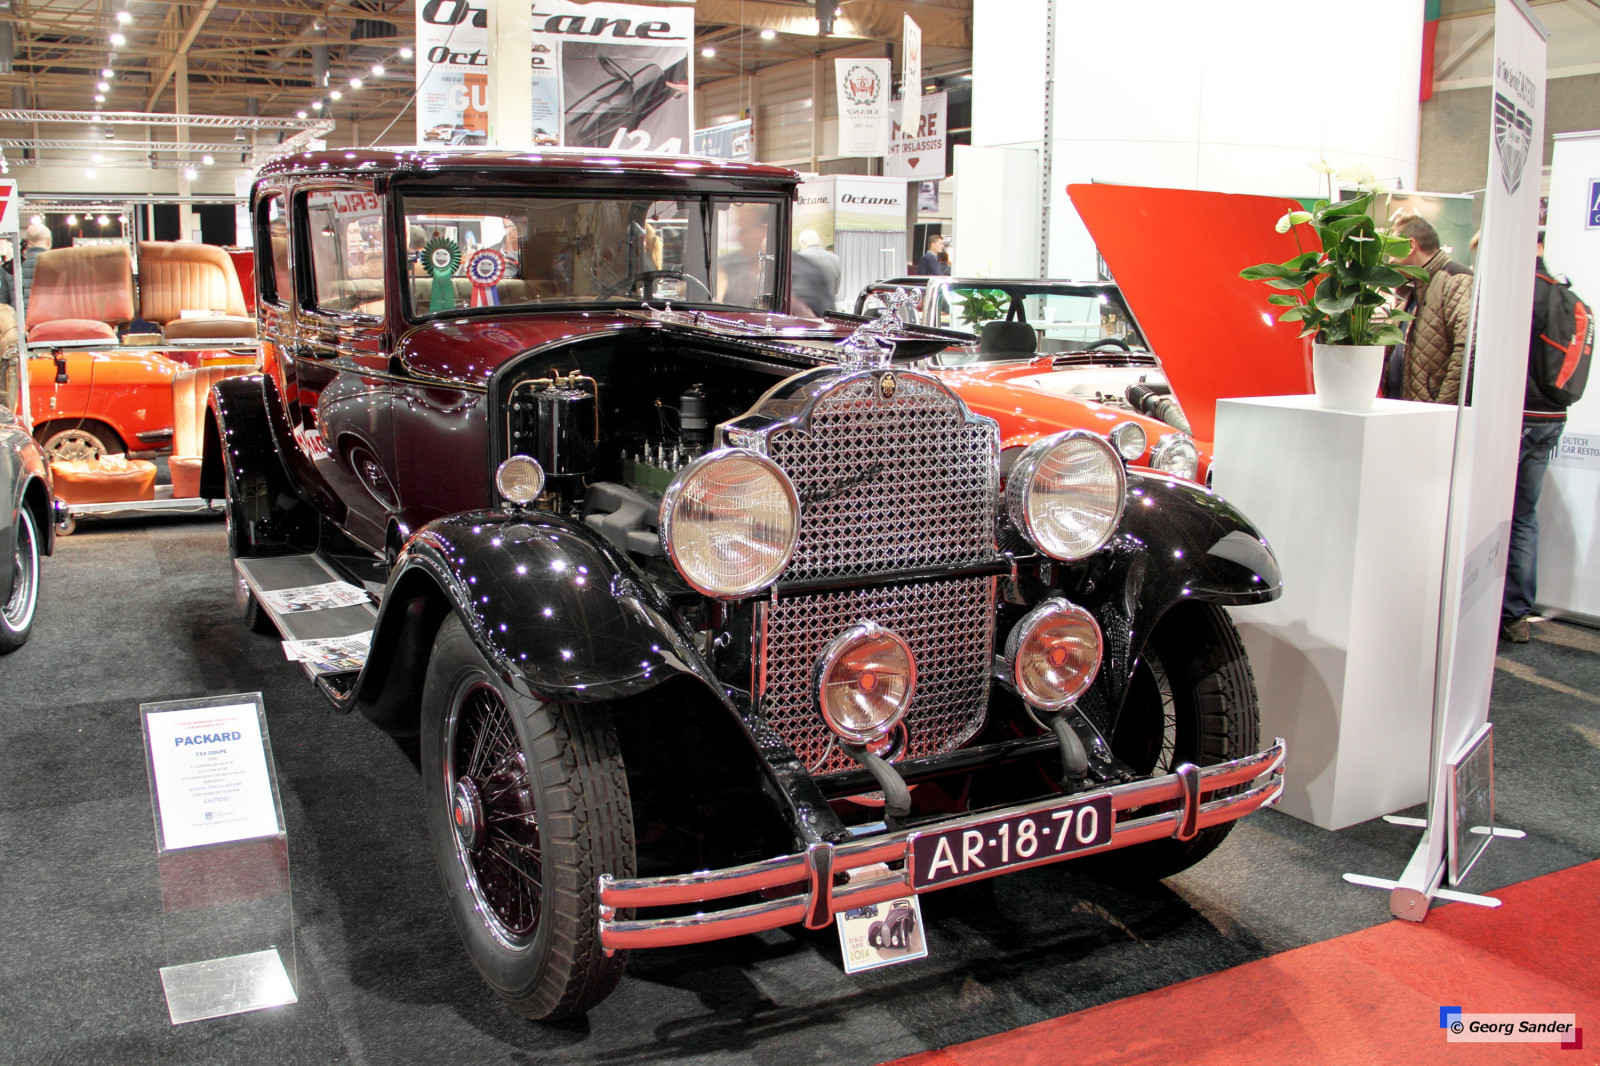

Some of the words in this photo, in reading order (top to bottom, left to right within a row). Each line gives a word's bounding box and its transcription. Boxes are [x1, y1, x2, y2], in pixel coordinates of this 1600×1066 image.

[892, 112, 938, 141] MRE
[797, 194, 830, 206] Octane
[841, 193, 901, 206] Octane
[1562, 436, 1588, 446] DUTCH
[1561, 445, 1576, 454] CAR
[1577, 446, 1600, 457] RESTO
[174, 731, 242, 747] PACKARD
[927, 805, 1098, 880] AR-18-70
